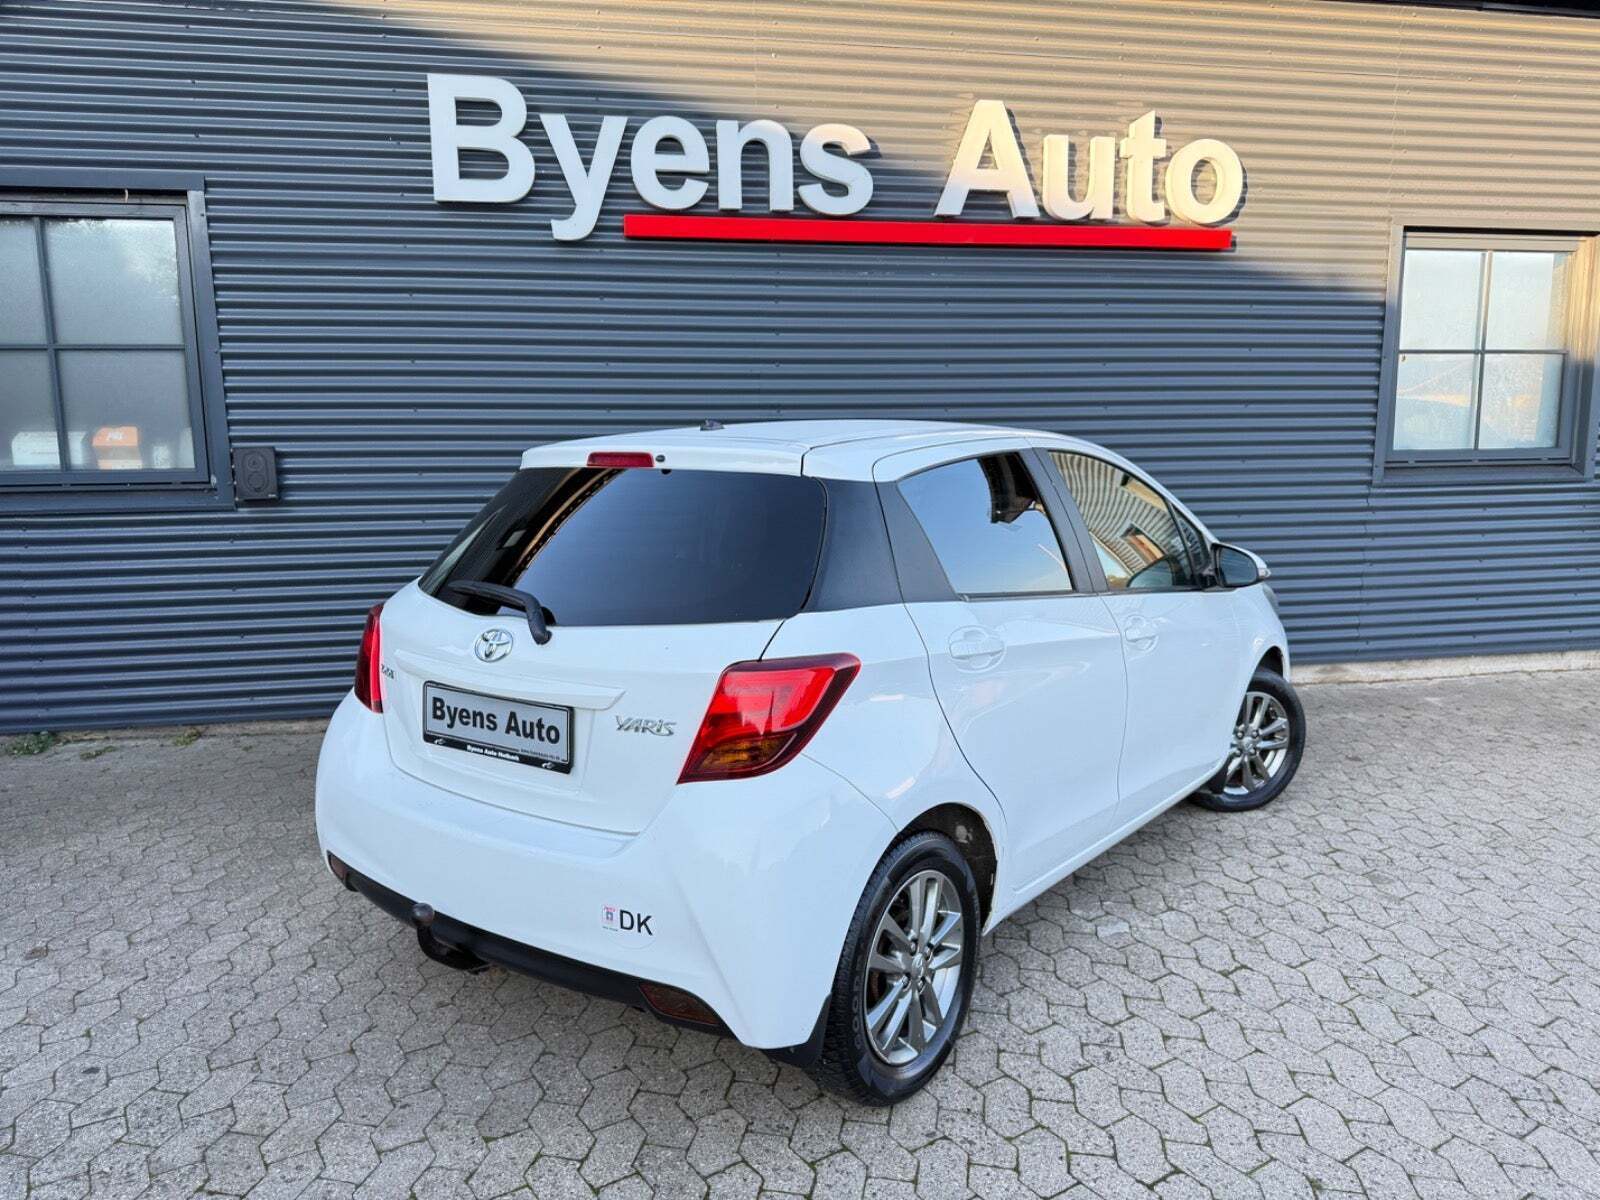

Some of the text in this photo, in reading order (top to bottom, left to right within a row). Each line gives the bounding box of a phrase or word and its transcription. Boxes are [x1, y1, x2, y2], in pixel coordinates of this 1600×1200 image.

[427, 73, 1244, 241] Byens Auto
[431, 696, 561, 744] Byens Auto
[615, 715, 677, 736] YARIS
[619, 909, 653, 936] DK
